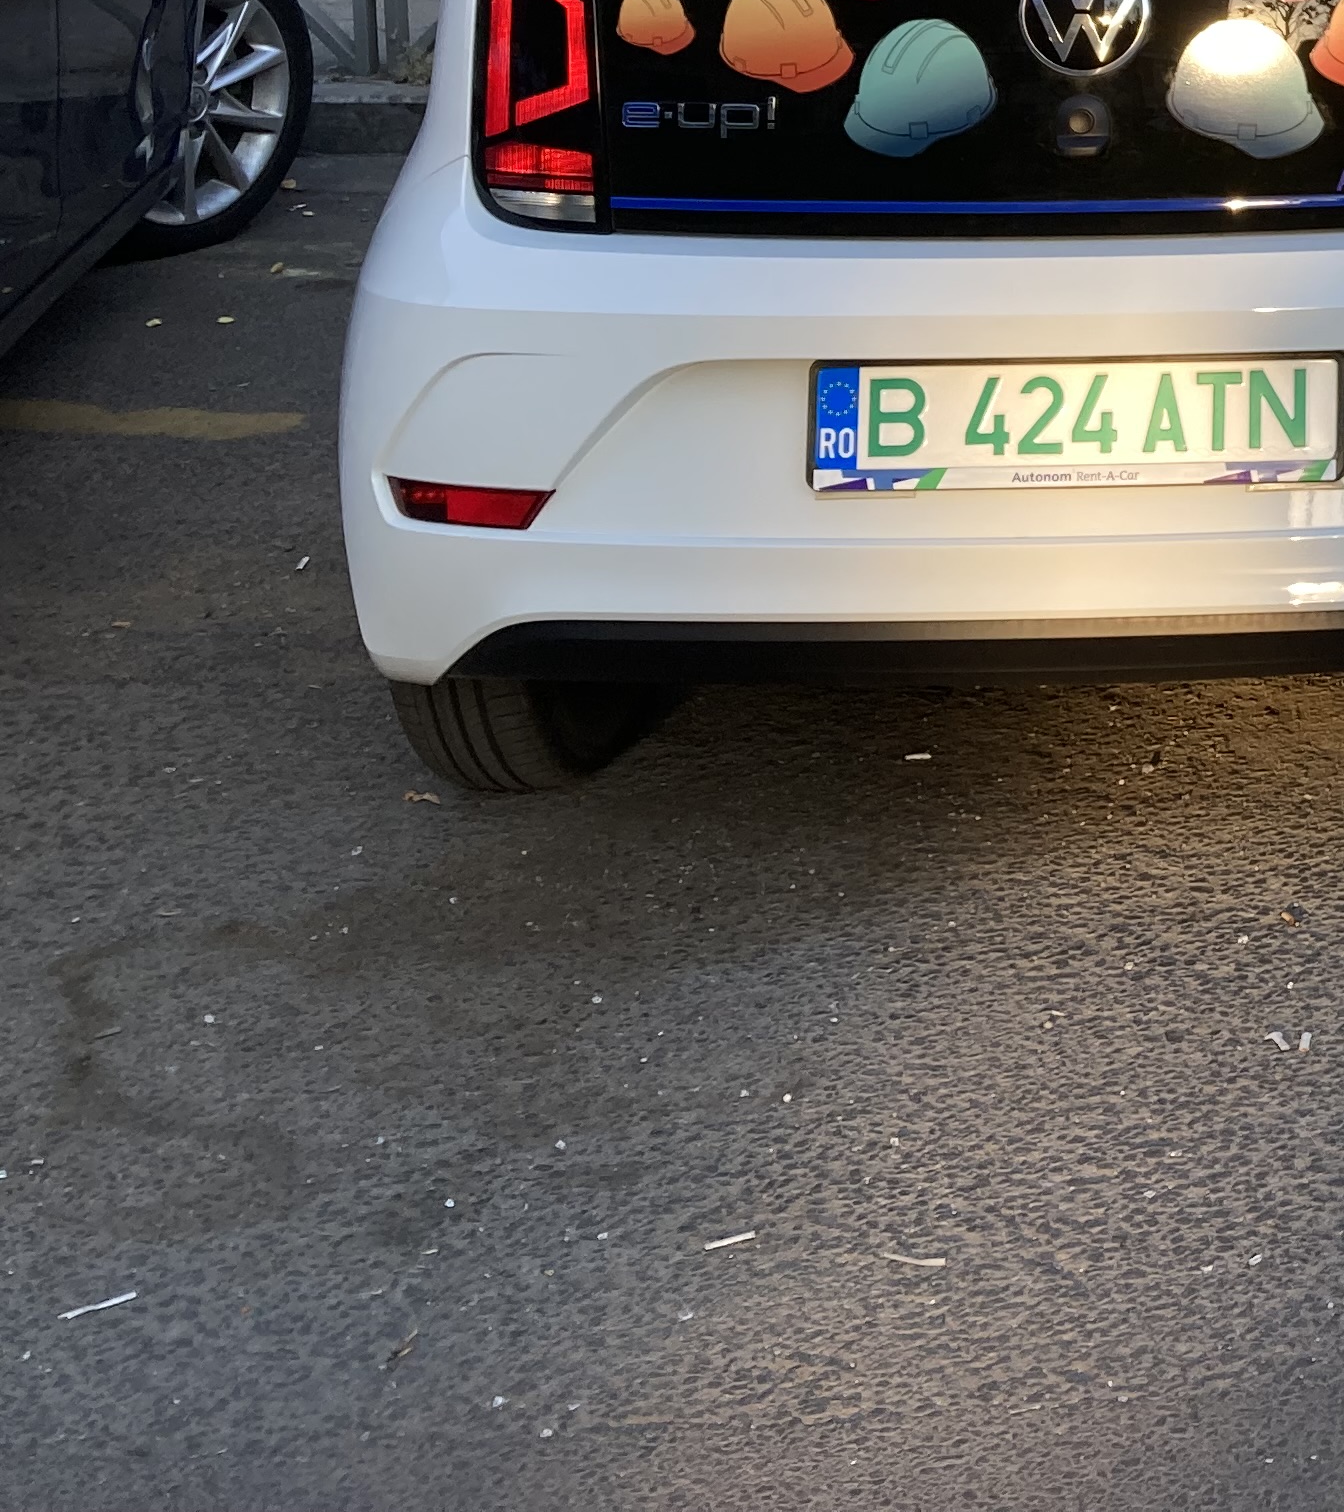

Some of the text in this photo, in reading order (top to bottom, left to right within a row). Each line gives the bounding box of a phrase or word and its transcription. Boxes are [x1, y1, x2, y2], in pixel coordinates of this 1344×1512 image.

[868, 368, 1307, 457] B 424 ATN
[818, 427, 856, 459] RO
[1012, 470, 1140, 483] Autonom Rent-A-Car
